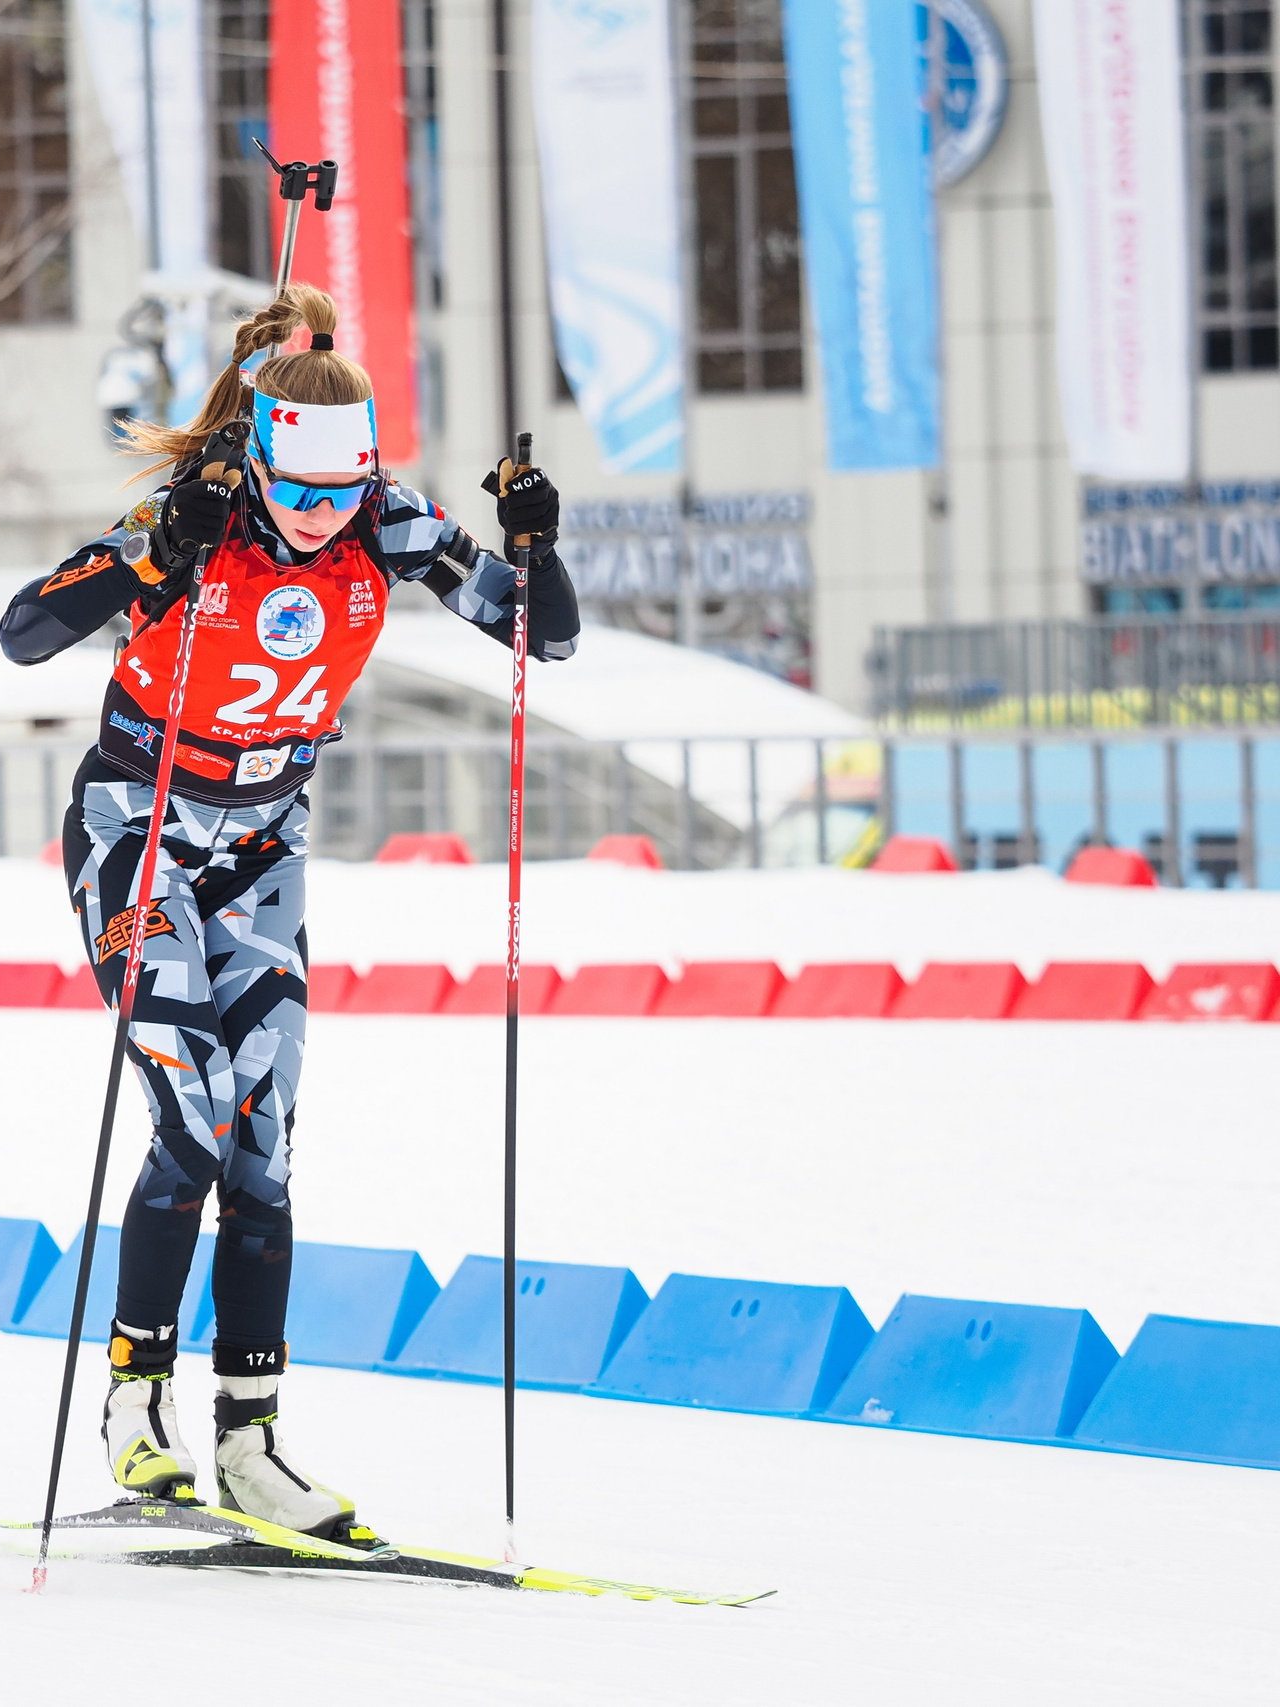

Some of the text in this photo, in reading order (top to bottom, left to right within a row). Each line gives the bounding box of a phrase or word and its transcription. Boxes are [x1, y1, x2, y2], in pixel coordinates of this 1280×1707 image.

[262, 587, 300, 607] ПЕРВЕНСТВО
[513, 604, 525, 718] MOAX
[214, 663, 329, 725] 24
[211, 725, 311, 741] КРАСНОЯРСК
[191, 750, 231, 769] КРАСНОЯРСКИЙ
[128, 906, 147, 988] MOAX
[246, 1352, 276, 1366] 174
[141, 1507, 166, 1517] FISCHER
